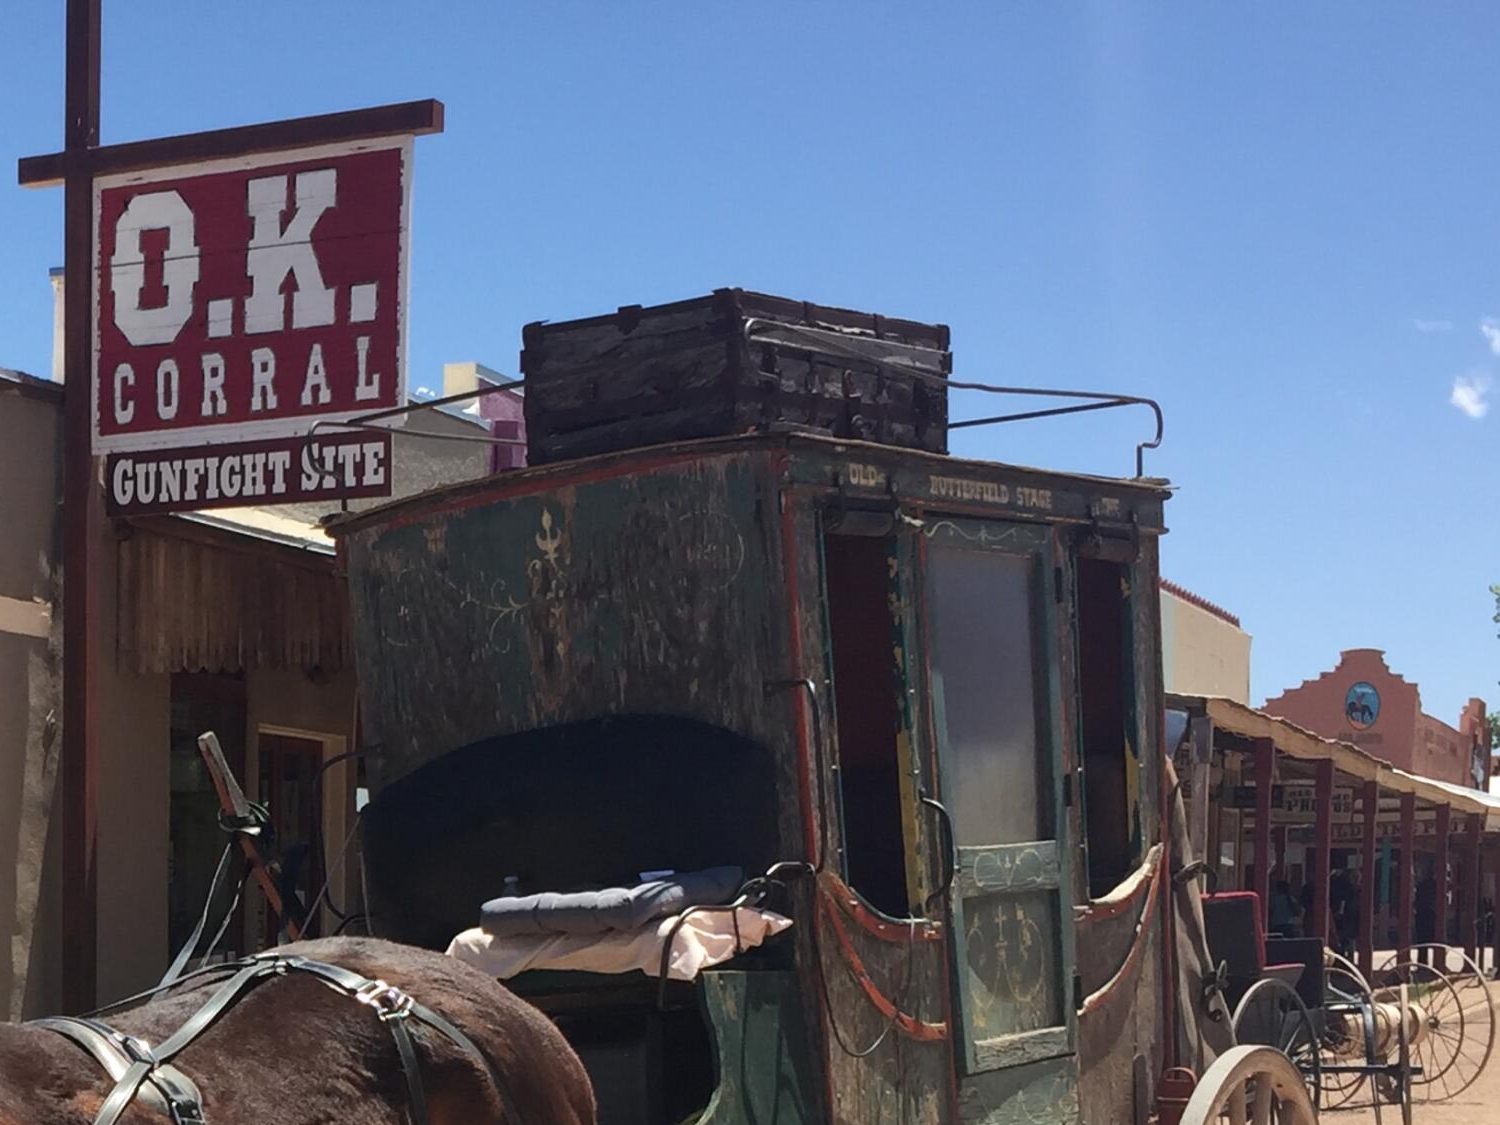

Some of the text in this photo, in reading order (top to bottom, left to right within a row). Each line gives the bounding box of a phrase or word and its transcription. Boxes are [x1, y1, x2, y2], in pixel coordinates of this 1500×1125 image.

[113, 335, 381, 426] CORRAL
[112, 441, 386, 507] GUNFIGHT SITE
[848, 463, 877, 488] OLD
[929, 474, 1010, 505] BUTTERFIELD
[1016, 486, 1053, 510] STAGE
